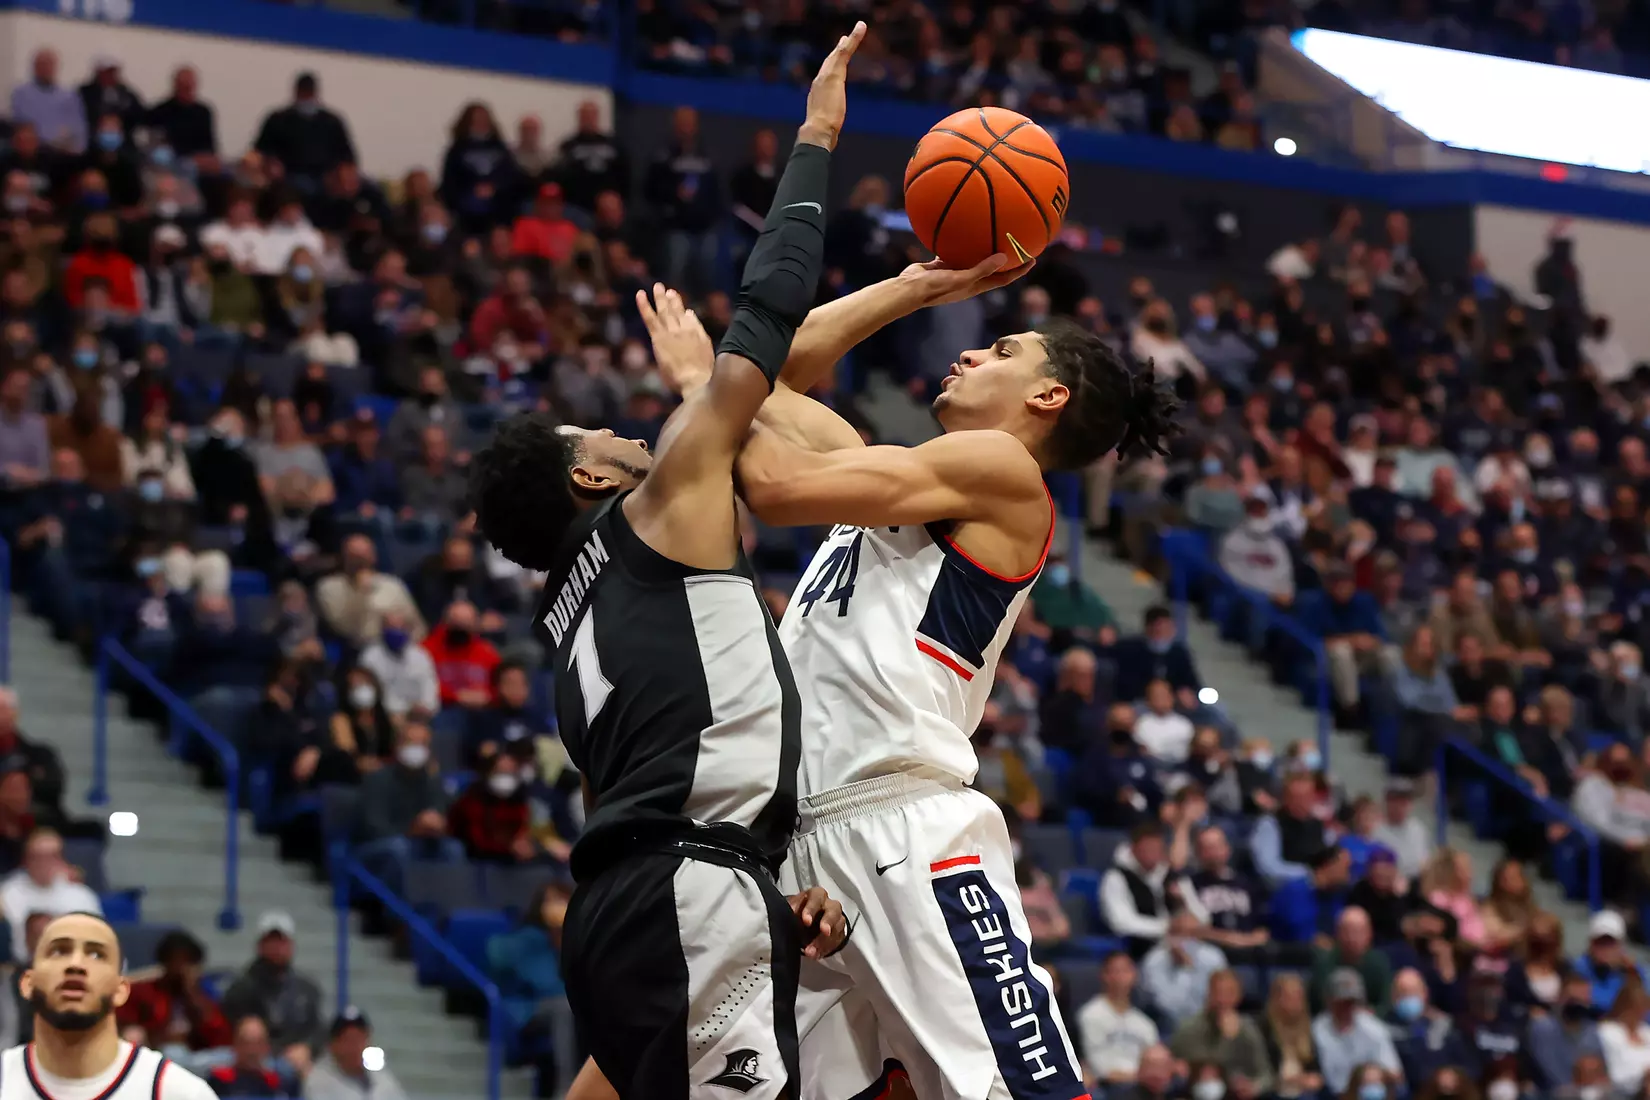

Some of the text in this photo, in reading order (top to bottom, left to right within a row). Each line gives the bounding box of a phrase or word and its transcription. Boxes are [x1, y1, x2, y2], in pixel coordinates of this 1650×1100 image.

[543, 529, 610, 648] DURHAM
[798, 531, 864, 617] 44
[567, 604, 615, 729] 1
[959, 884, 1057, 1082] HUSKIES
